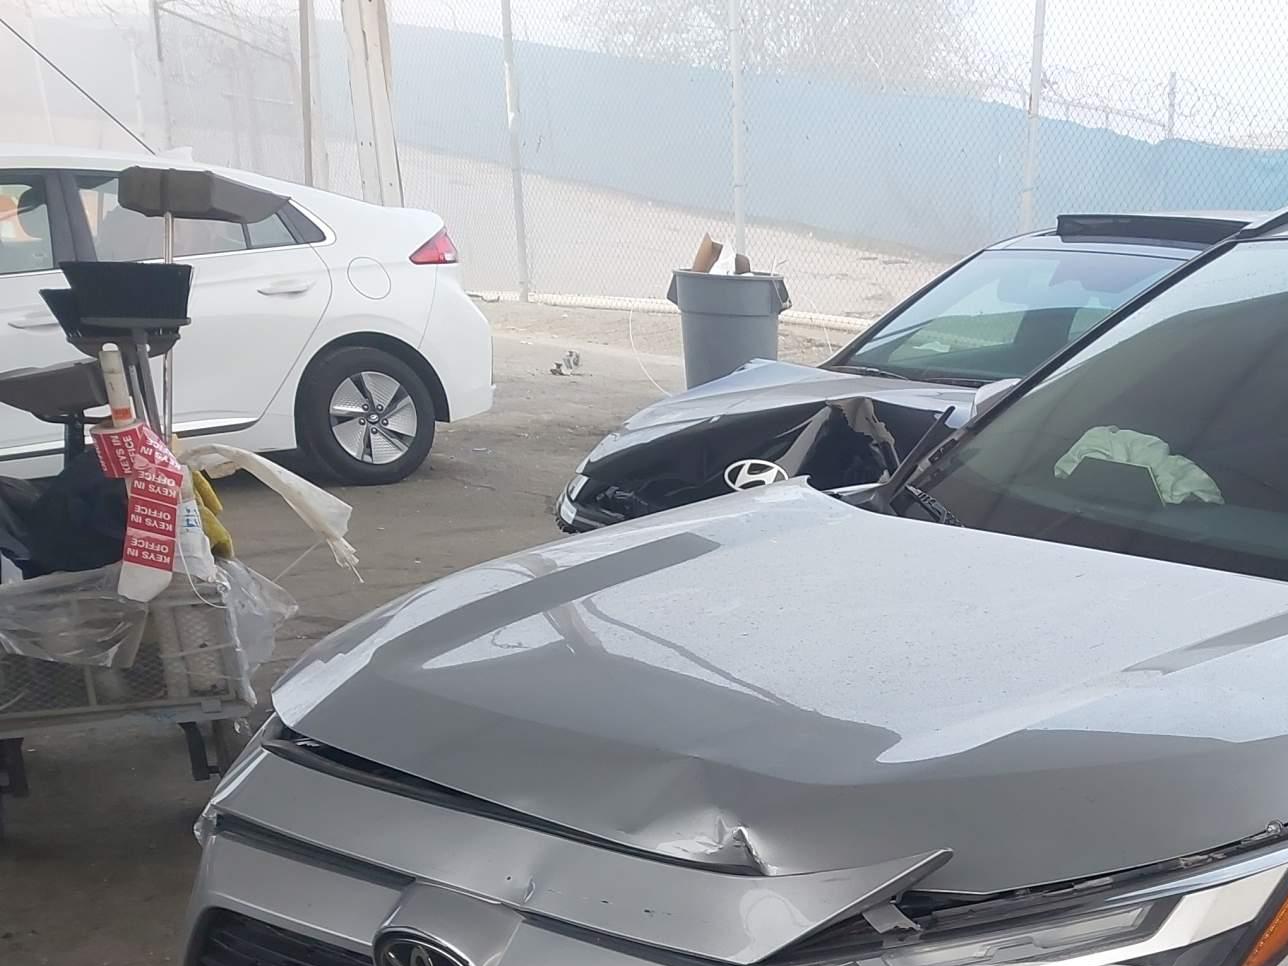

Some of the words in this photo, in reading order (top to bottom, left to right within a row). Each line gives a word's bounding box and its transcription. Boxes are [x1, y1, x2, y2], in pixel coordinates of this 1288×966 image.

[133, 480, 145, 490] IN
[138, 470, 176, 487] OFFICE
[148, 484, 177, 499] KEYS
[130, 513, 143, 523] IN
[133, 504, 171, 521] OFFICE
[144, 517, 173, 532] KEYS
[126, 547, 139, 557] IN
[130, 537, 169, 554] OFFICE
[141, 551, 171, 565] KEYS
